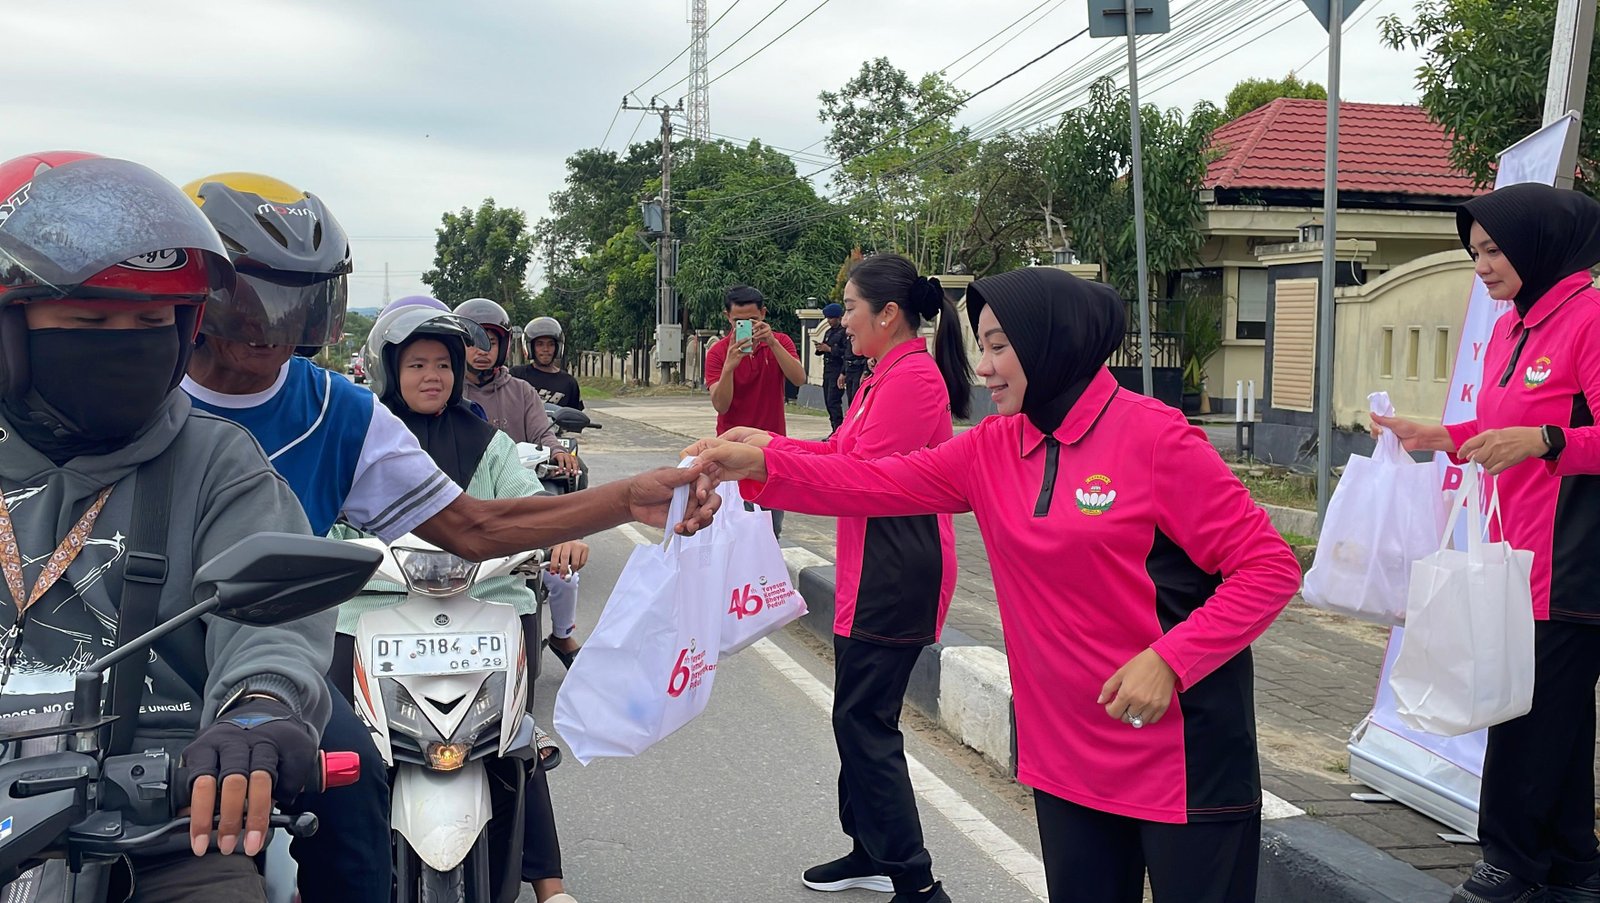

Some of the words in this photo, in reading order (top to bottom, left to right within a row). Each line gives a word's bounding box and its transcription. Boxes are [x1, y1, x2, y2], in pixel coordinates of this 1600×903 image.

[378, 639, 402, 657] DT
[478, 636, 501, 652] FD
[148, 702, 192, 714] UNIQUE
